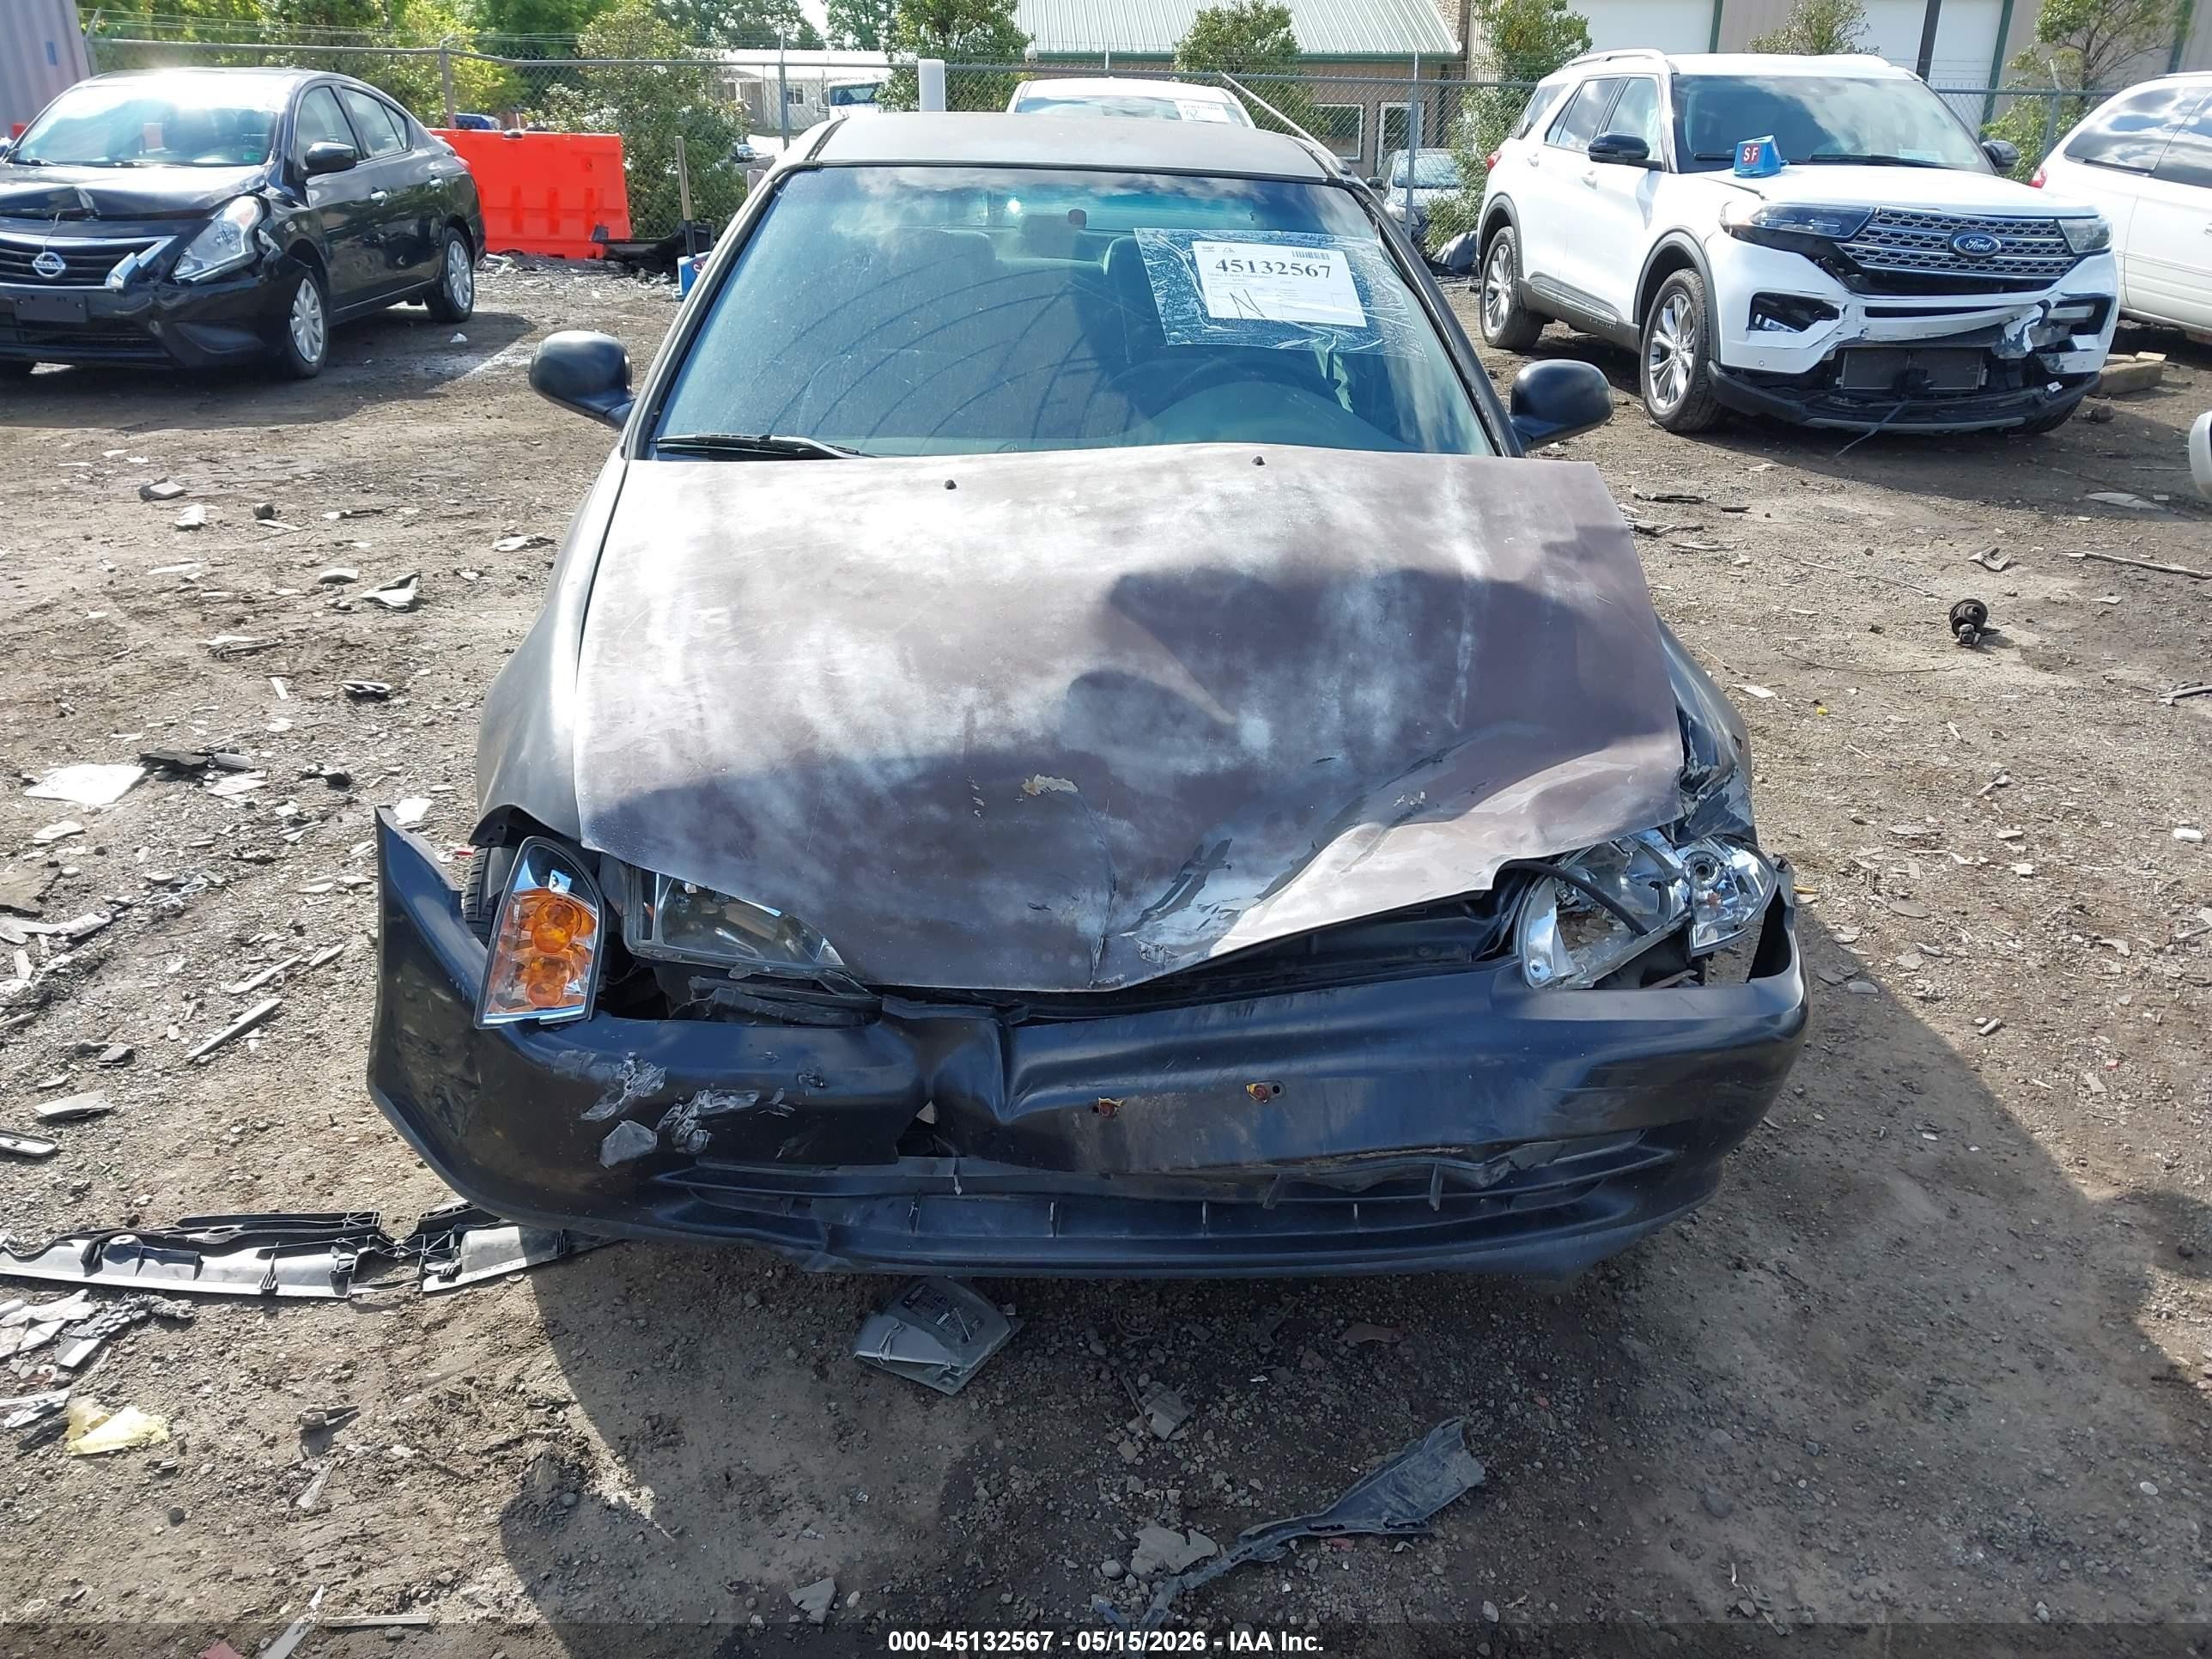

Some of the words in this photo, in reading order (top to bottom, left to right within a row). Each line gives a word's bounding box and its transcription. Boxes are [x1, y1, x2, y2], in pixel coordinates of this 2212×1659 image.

[1743, 147, 1759, 161] SF
[1966, 237, 1991, 251] Ford
[1215, 258, 1331, 278] 45132567
